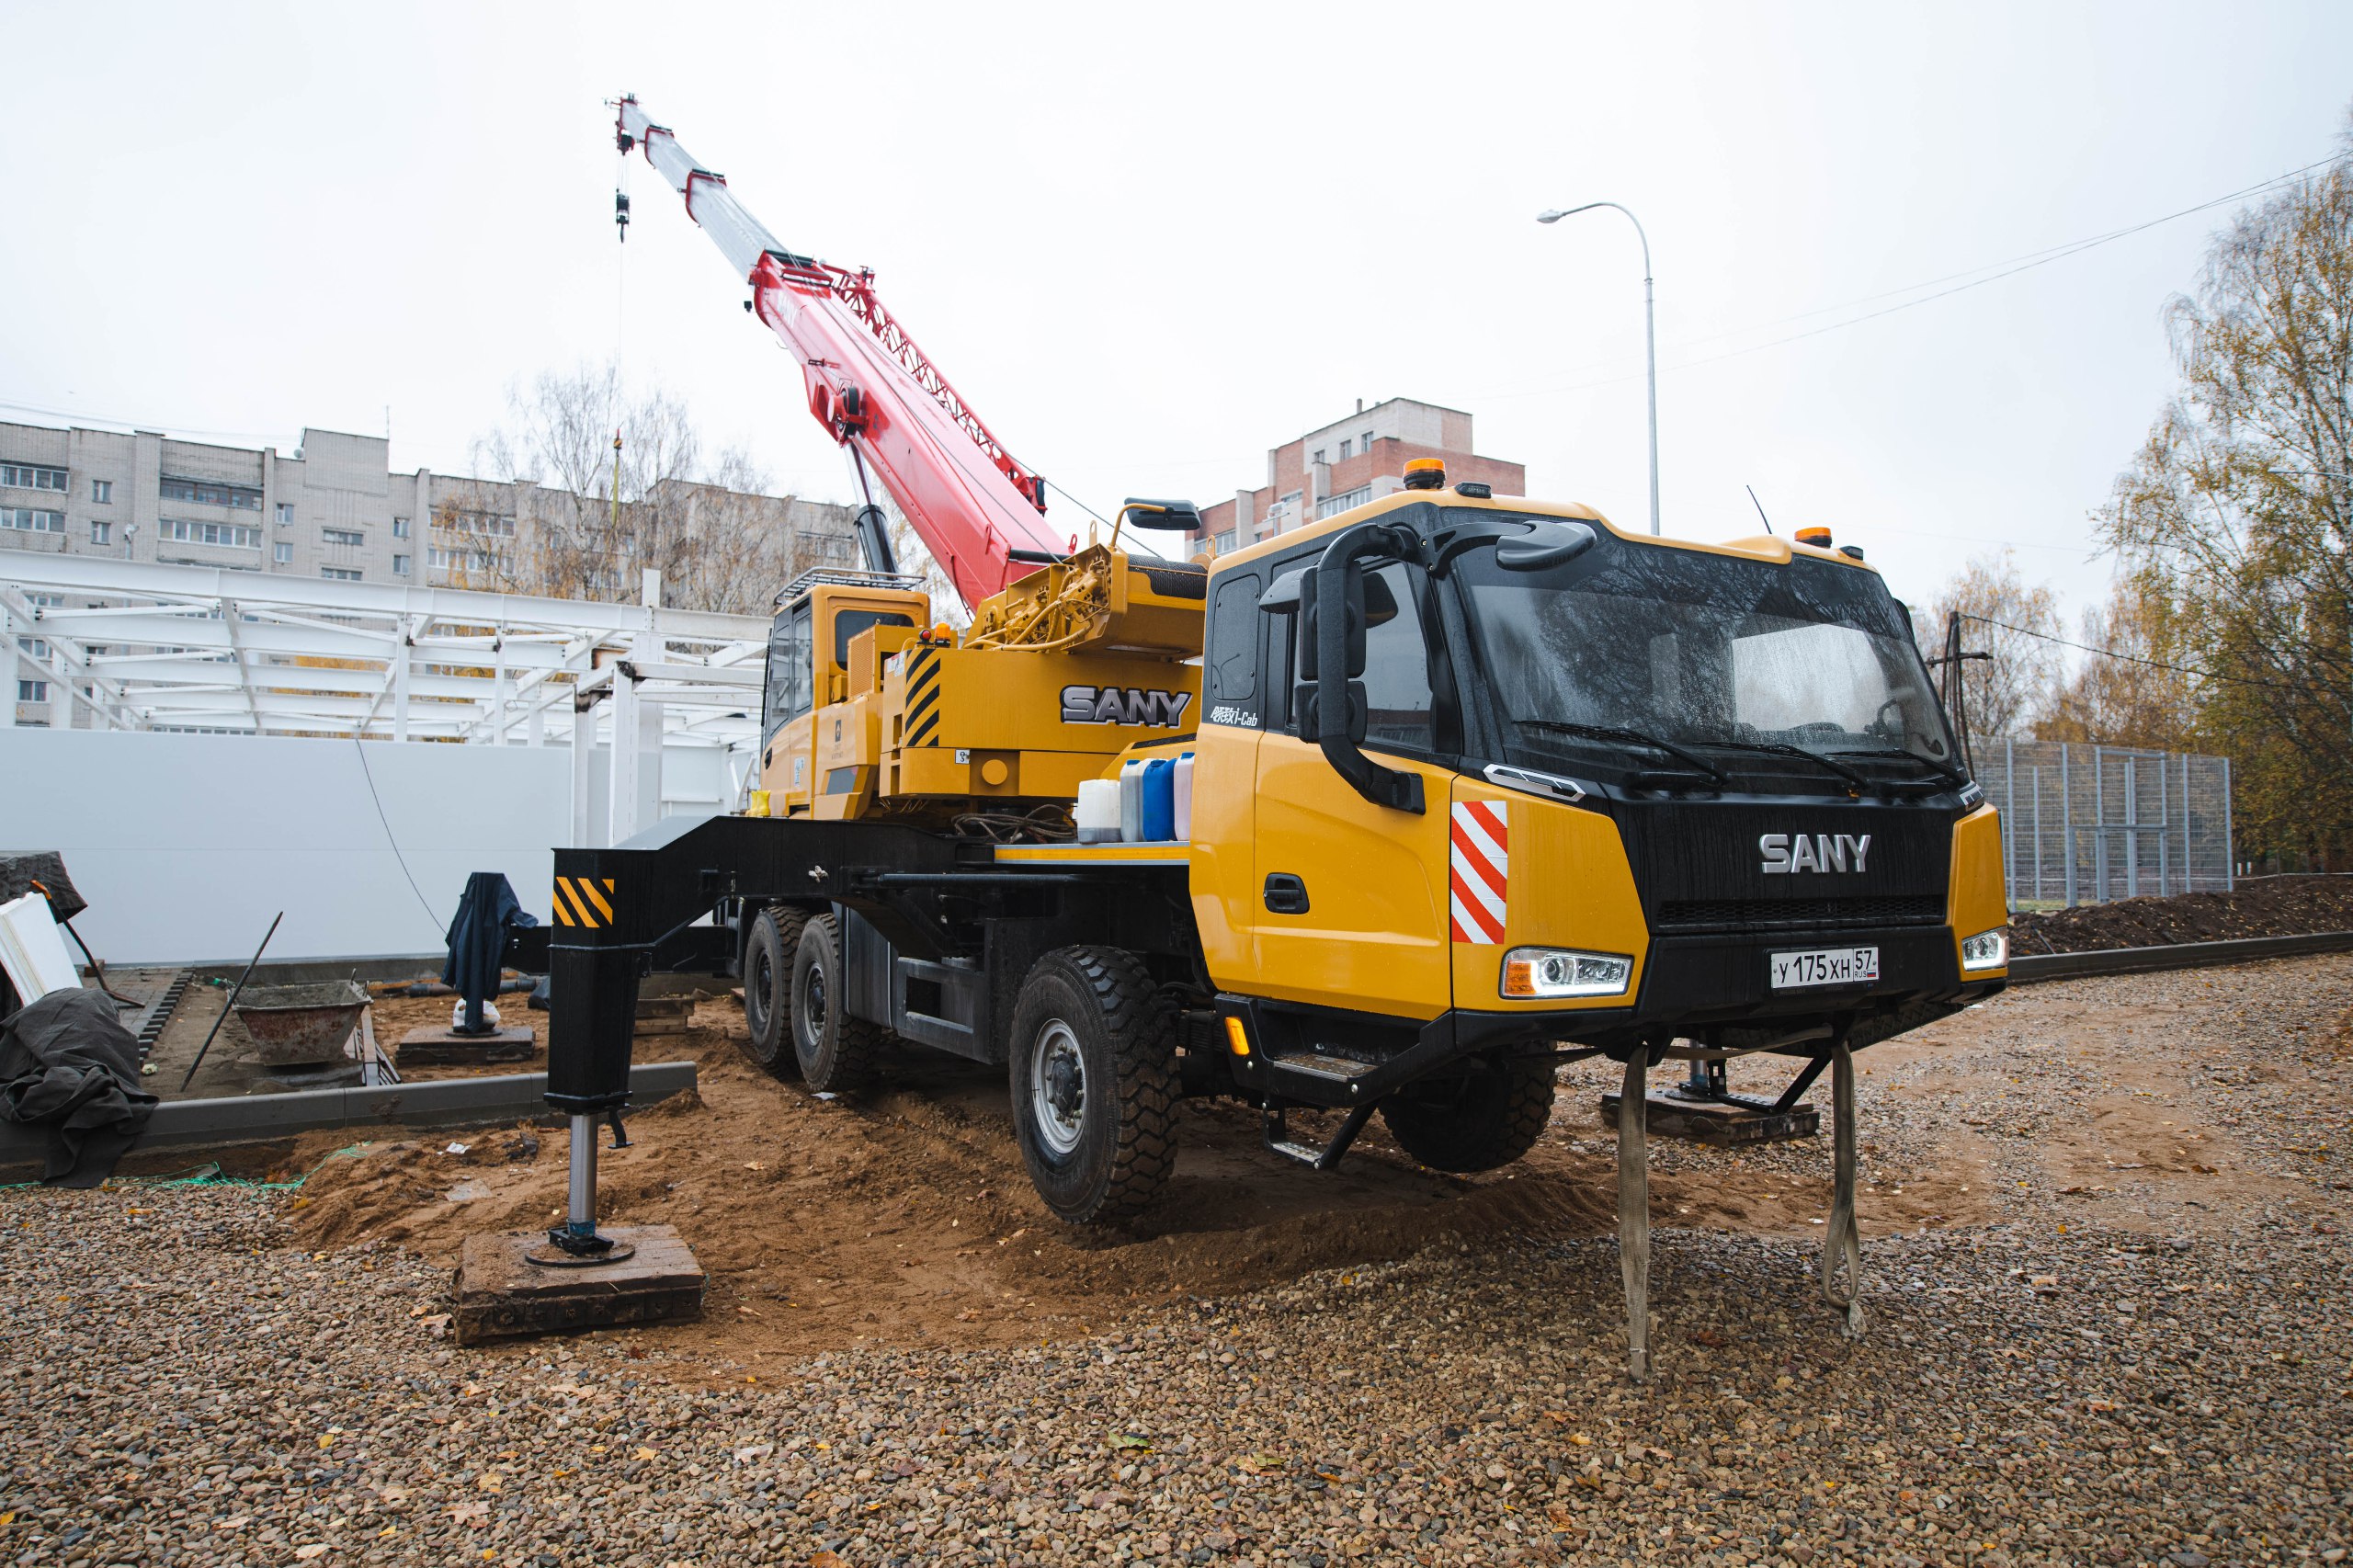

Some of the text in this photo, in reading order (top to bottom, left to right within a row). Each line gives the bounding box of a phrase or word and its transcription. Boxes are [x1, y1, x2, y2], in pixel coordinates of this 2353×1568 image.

[1061, 686, 1191, 727] SANY
[1759, 834, 1871, 873] SANY
[1854, 970, 1867, 978] RUS
[1855, 950, 1872, 971] 57
